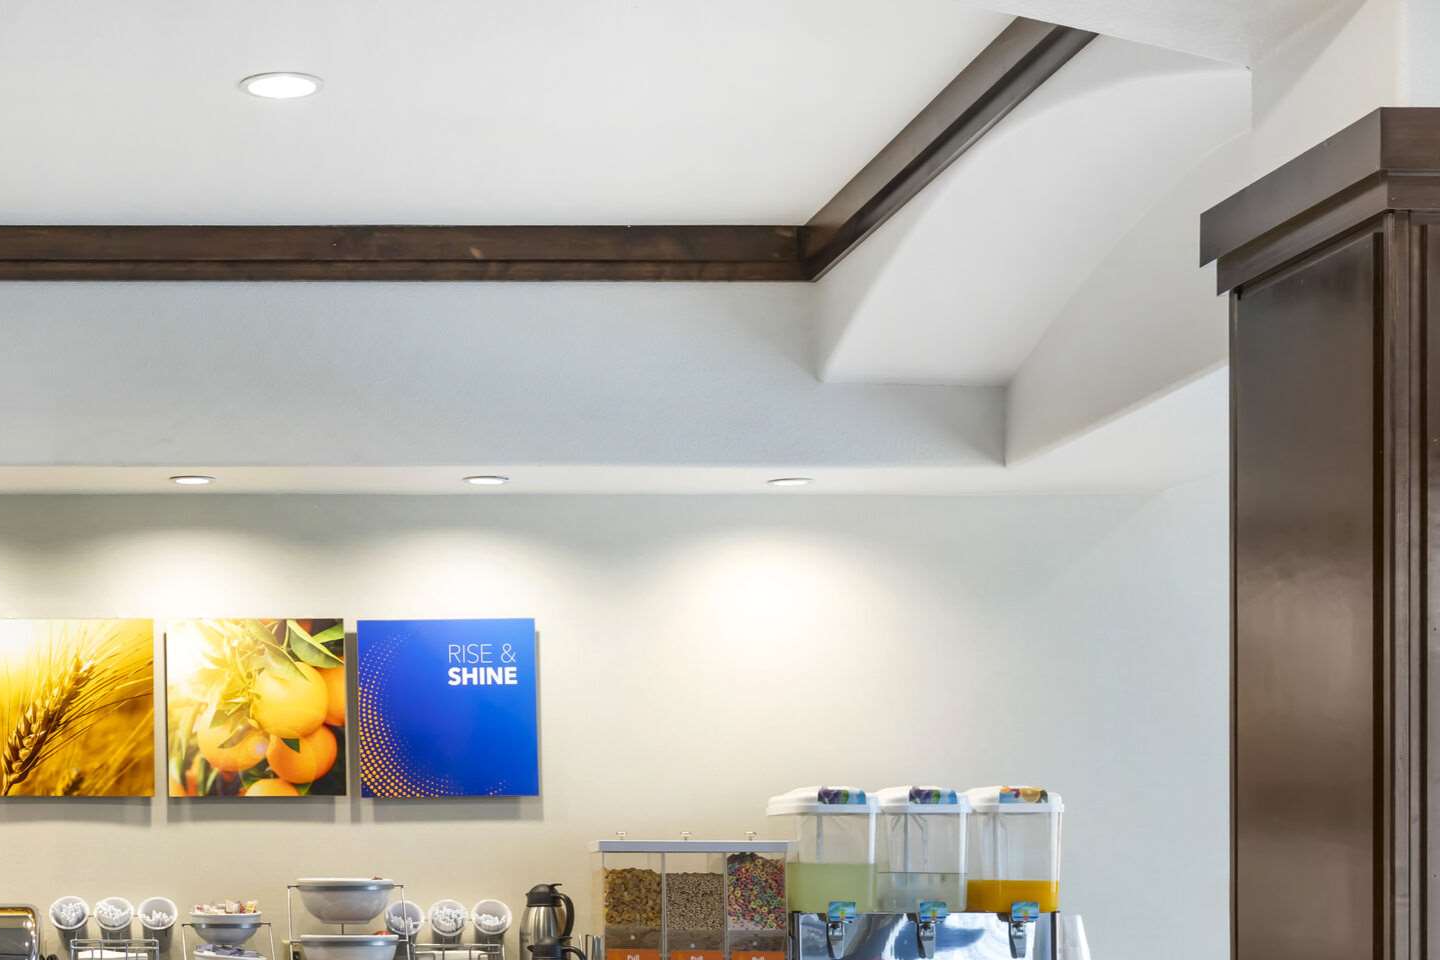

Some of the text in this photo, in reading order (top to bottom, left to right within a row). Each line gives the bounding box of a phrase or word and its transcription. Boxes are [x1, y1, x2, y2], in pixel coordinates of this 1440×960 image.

[448, 643, 517, 664] RISE &
[447, 666, 518, 686] SHINE
